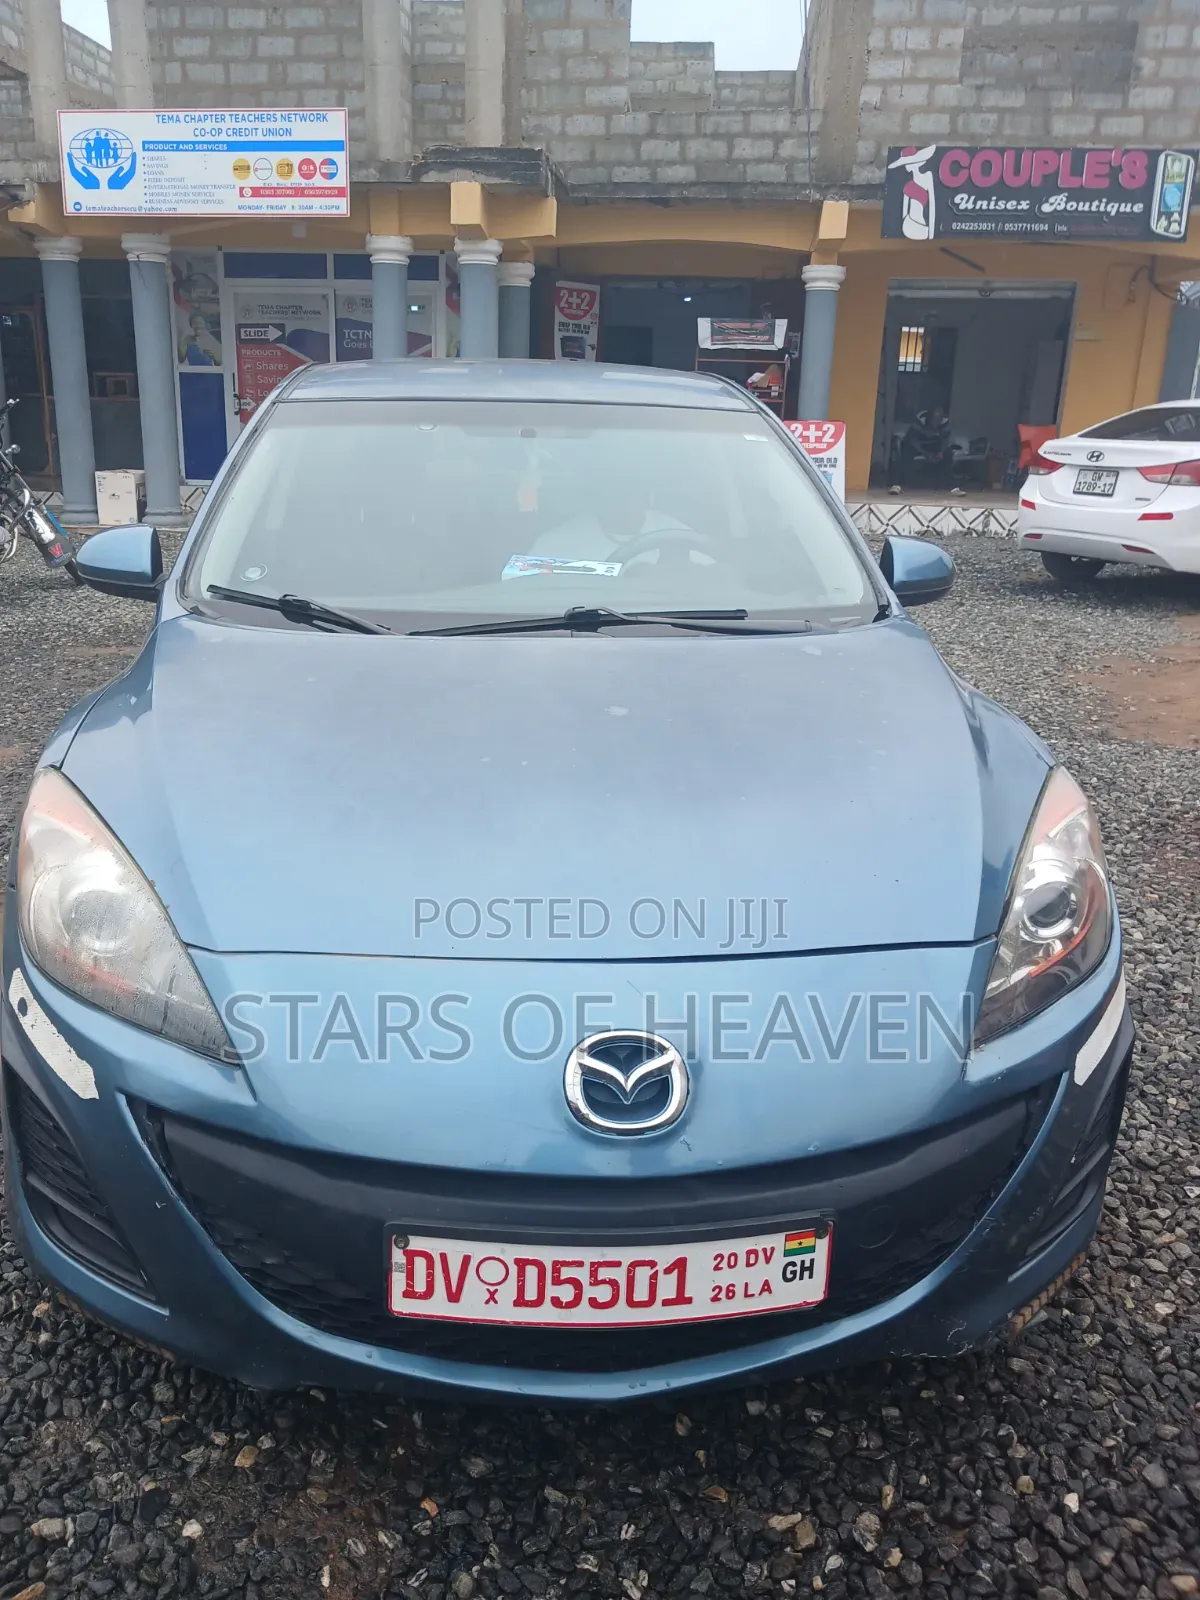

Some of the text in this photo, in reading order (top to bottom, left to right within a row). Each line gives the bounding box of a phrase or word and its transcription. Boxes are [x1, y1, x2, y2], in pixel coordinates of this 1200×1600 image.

[156, 113, 328, 123] TEMA CHAPTER TEACHERS NETWORK
[193, 128, 292, 137] CO-OP CREDIT UNION
[939, 149, 1148, 189] COUPLE'S
[954, 192, 1144, 216] Unisex Boutique
[560, 290, 590, 310] 2+2
[343, 330, 372, 339] TCTN
[344, 340, 367, 348] Goes
[256, 361, 288, 370] Shares
[790, 423, 836, 442] 2+2
[1076, 482, 1113, 493] 1789-17
[713, 1246, 775, 1271] 20 DV
[402, 1248, 472, 1303] DV
[513, 1256, 693, 1310] D5501
[782, 1258, 815, 1283] GH
[710, 1279, 772, 1302] 26 LA
